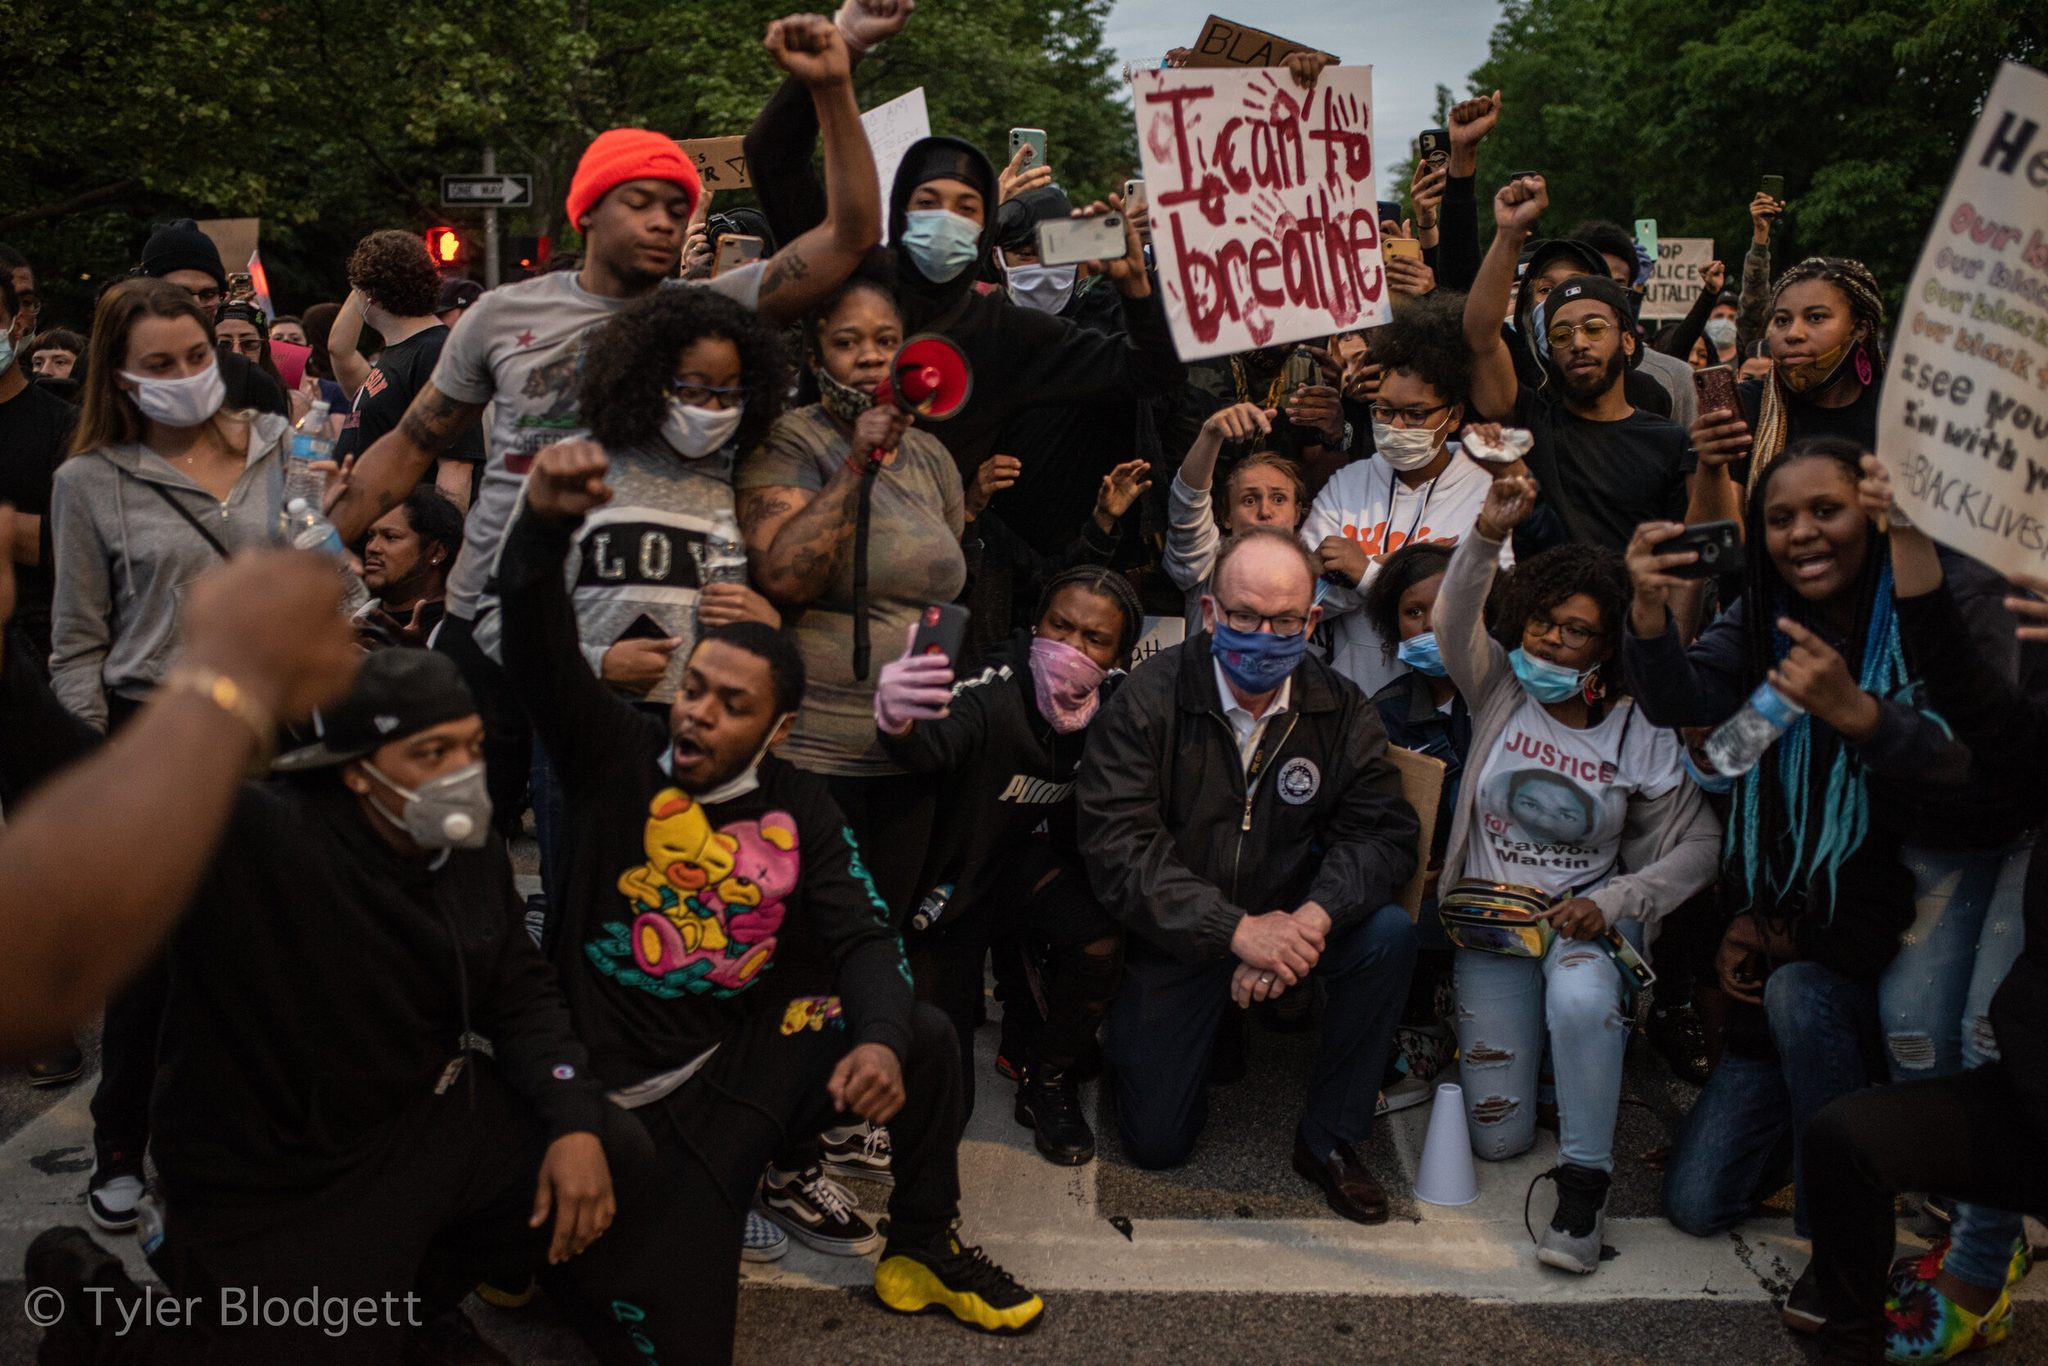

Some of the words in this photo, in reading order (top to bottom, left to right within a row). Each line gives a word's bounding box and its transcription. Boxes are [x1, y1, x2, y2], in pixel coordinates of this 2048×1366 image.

[1146, 86, 1228, 206] I
[1949, 202, 2022, 252] Our
[1170, 189, 1383, 342] breathe
[1661, 244, 1683, 259] OP
[1936, 247, 1984, 280] Our
[1922, 277, 1972, 314] Our
[1916, 363, 1974, 406] see
[1943, 420, 2018, 472] with
[1505, 732, 1615, 785] JUSTICE
[1484, 812, 1513, 834] for
[1495, 849, 1589, 869] Martin
